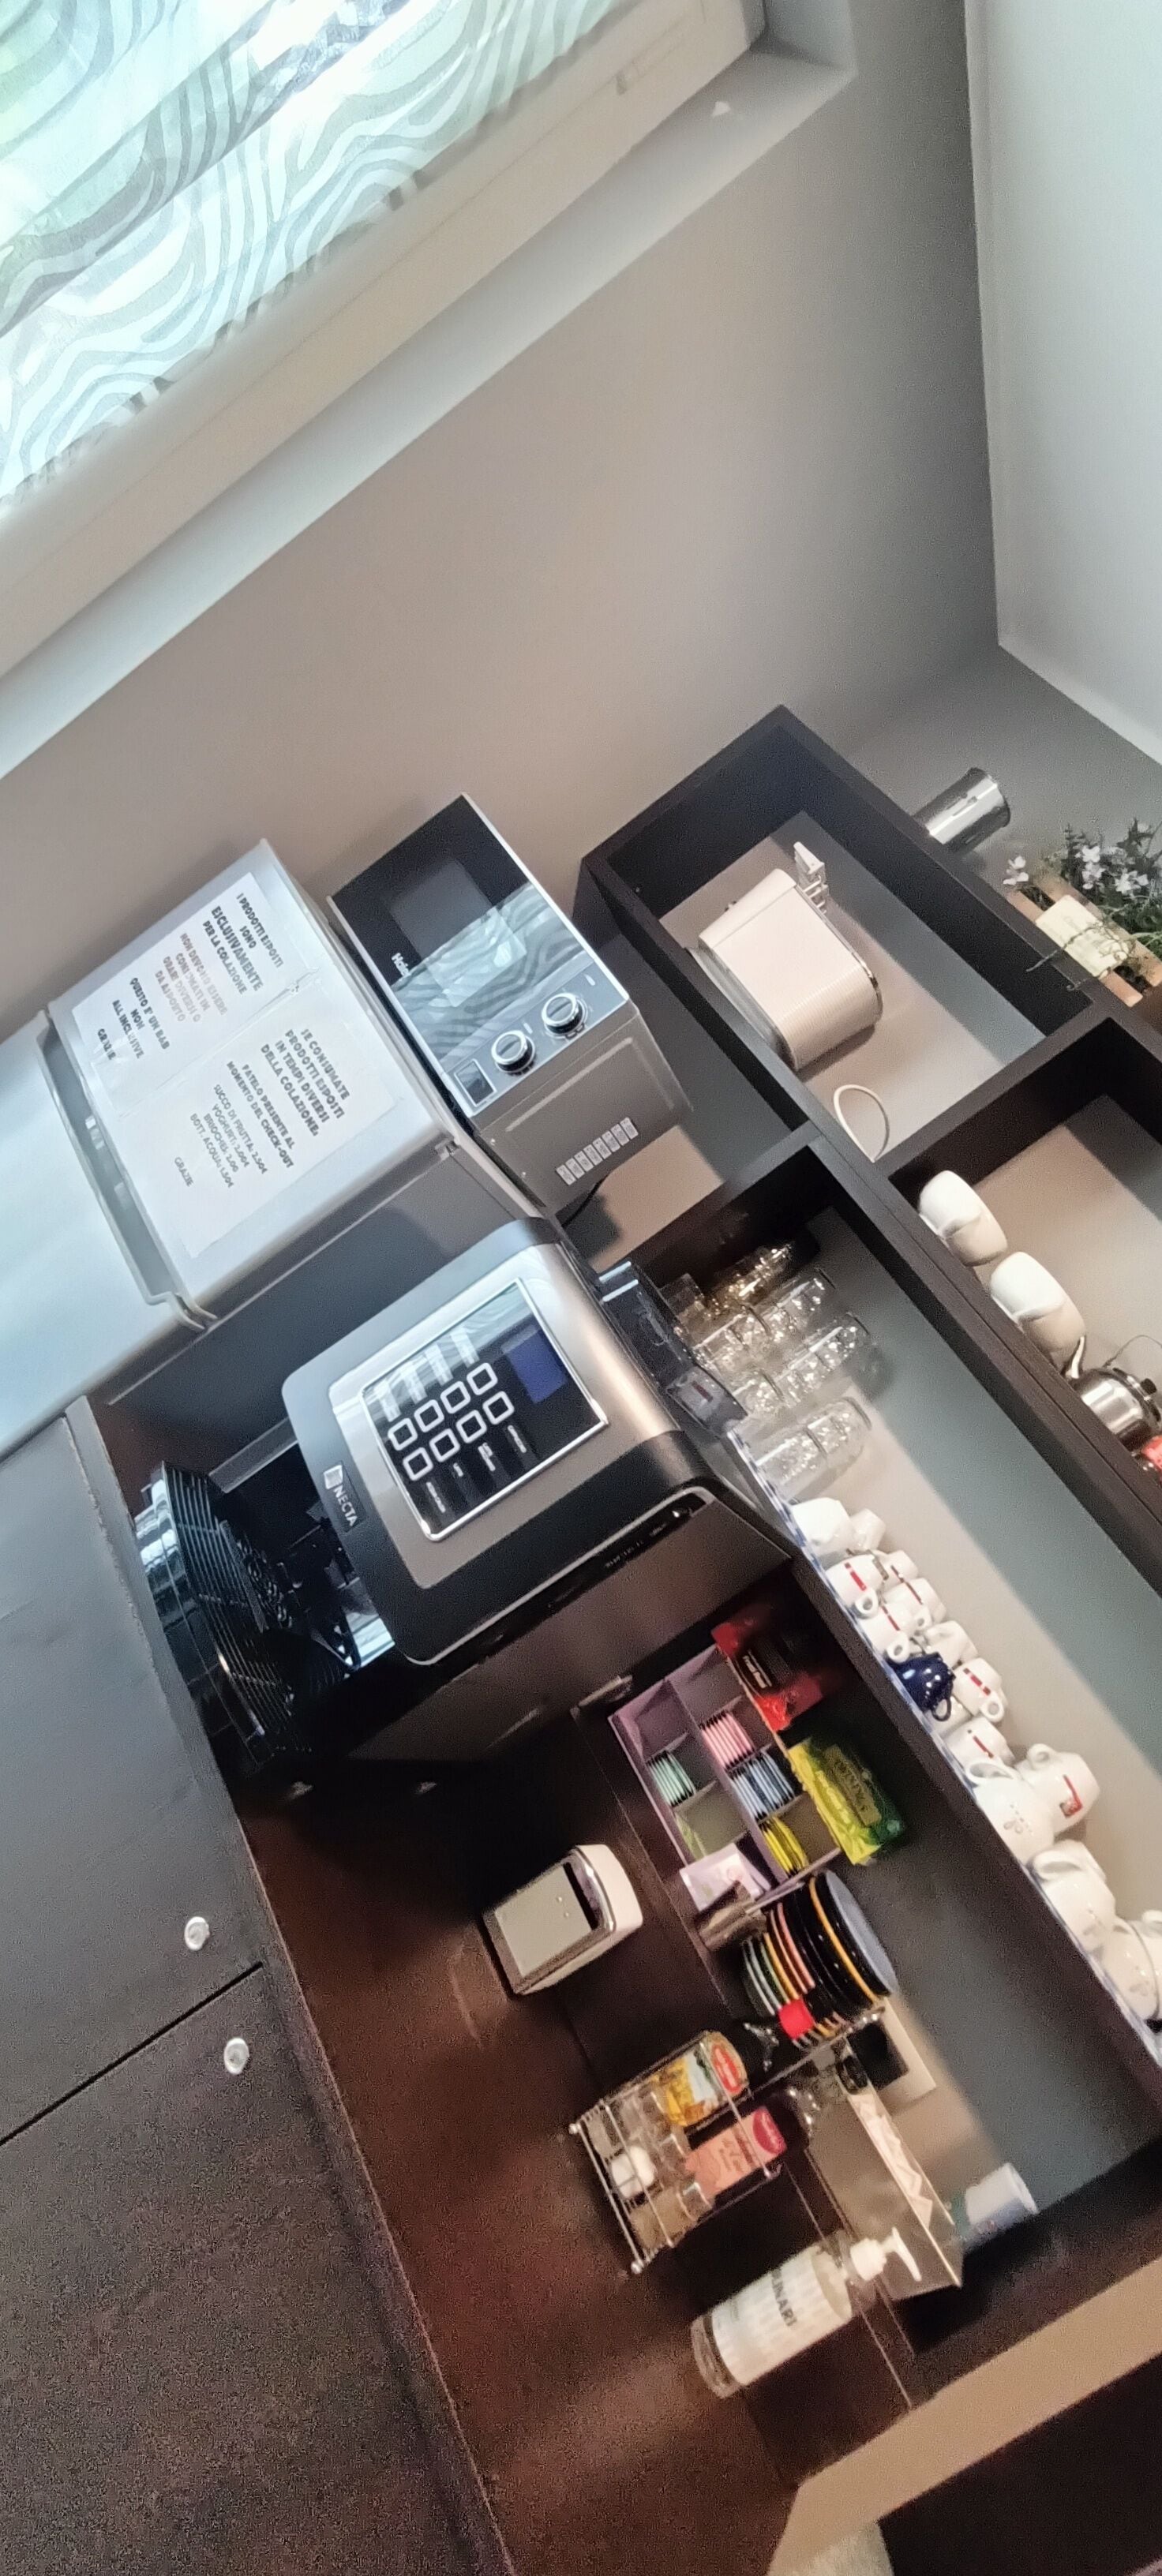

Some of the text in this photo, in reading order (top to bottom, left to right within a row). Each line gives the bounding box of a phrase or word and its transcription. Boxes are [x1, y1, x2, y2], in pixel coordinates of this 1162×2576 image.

[179, 932, 193, 951] NON
[202, 919, 247, 994] PER LA COLAZIONE
[210, 904, 263, 990] ESCLUSIVAMENTE
[238, 897, 265, 937] PRODOTTI
[259, 934, 283, 968] ESPOSTI
[238, 925, 257, 949] SONO
[129, 976, 170, 1050] QUESTO E' UN B&B
[129, 1008, 144, 1029] NON
[154, 969, 186, 1021] DA ASPORTO
[174, 979, 197, 1015] DIVERSI
[192, 1013, 201, 1022] O
[199, 998, 210, 1011] IN
[111, 998, 144, 1058] ALL INCLUSIVE
[260, 1043, 319, 1136] DELLA COLAZIONE:
[275, 1039, 330, 1122] IN TEMPI DIVERSI
[284, 1028, 345, 1119] PRODOTTI ESPOSTI
[300, 1028, 350, 1100] SE CONSUMATE
[202, 1112, 229, 1155] BRIOCHES:
[211, 1103, 237, 1145] YOGHURT:
[212, 1084, 231, 1110] SUCCO
[227, 1108, 237, 1120] DI
[233, 1118, 254, 1152] FRUTTA:
[226, 1060, 294, 1168] MOMENTO DEL CHECK-OUT
[241, 1063, 294, 1149] FATELO PRESENTE AL
[189, 1112, 206, 1137] BOTT.
[202, 1136, 222, 1168] ACQUA:
[174, 1156, 193, 1187] GRAZIE
[334, 1484, 358, 1526] NECTA
